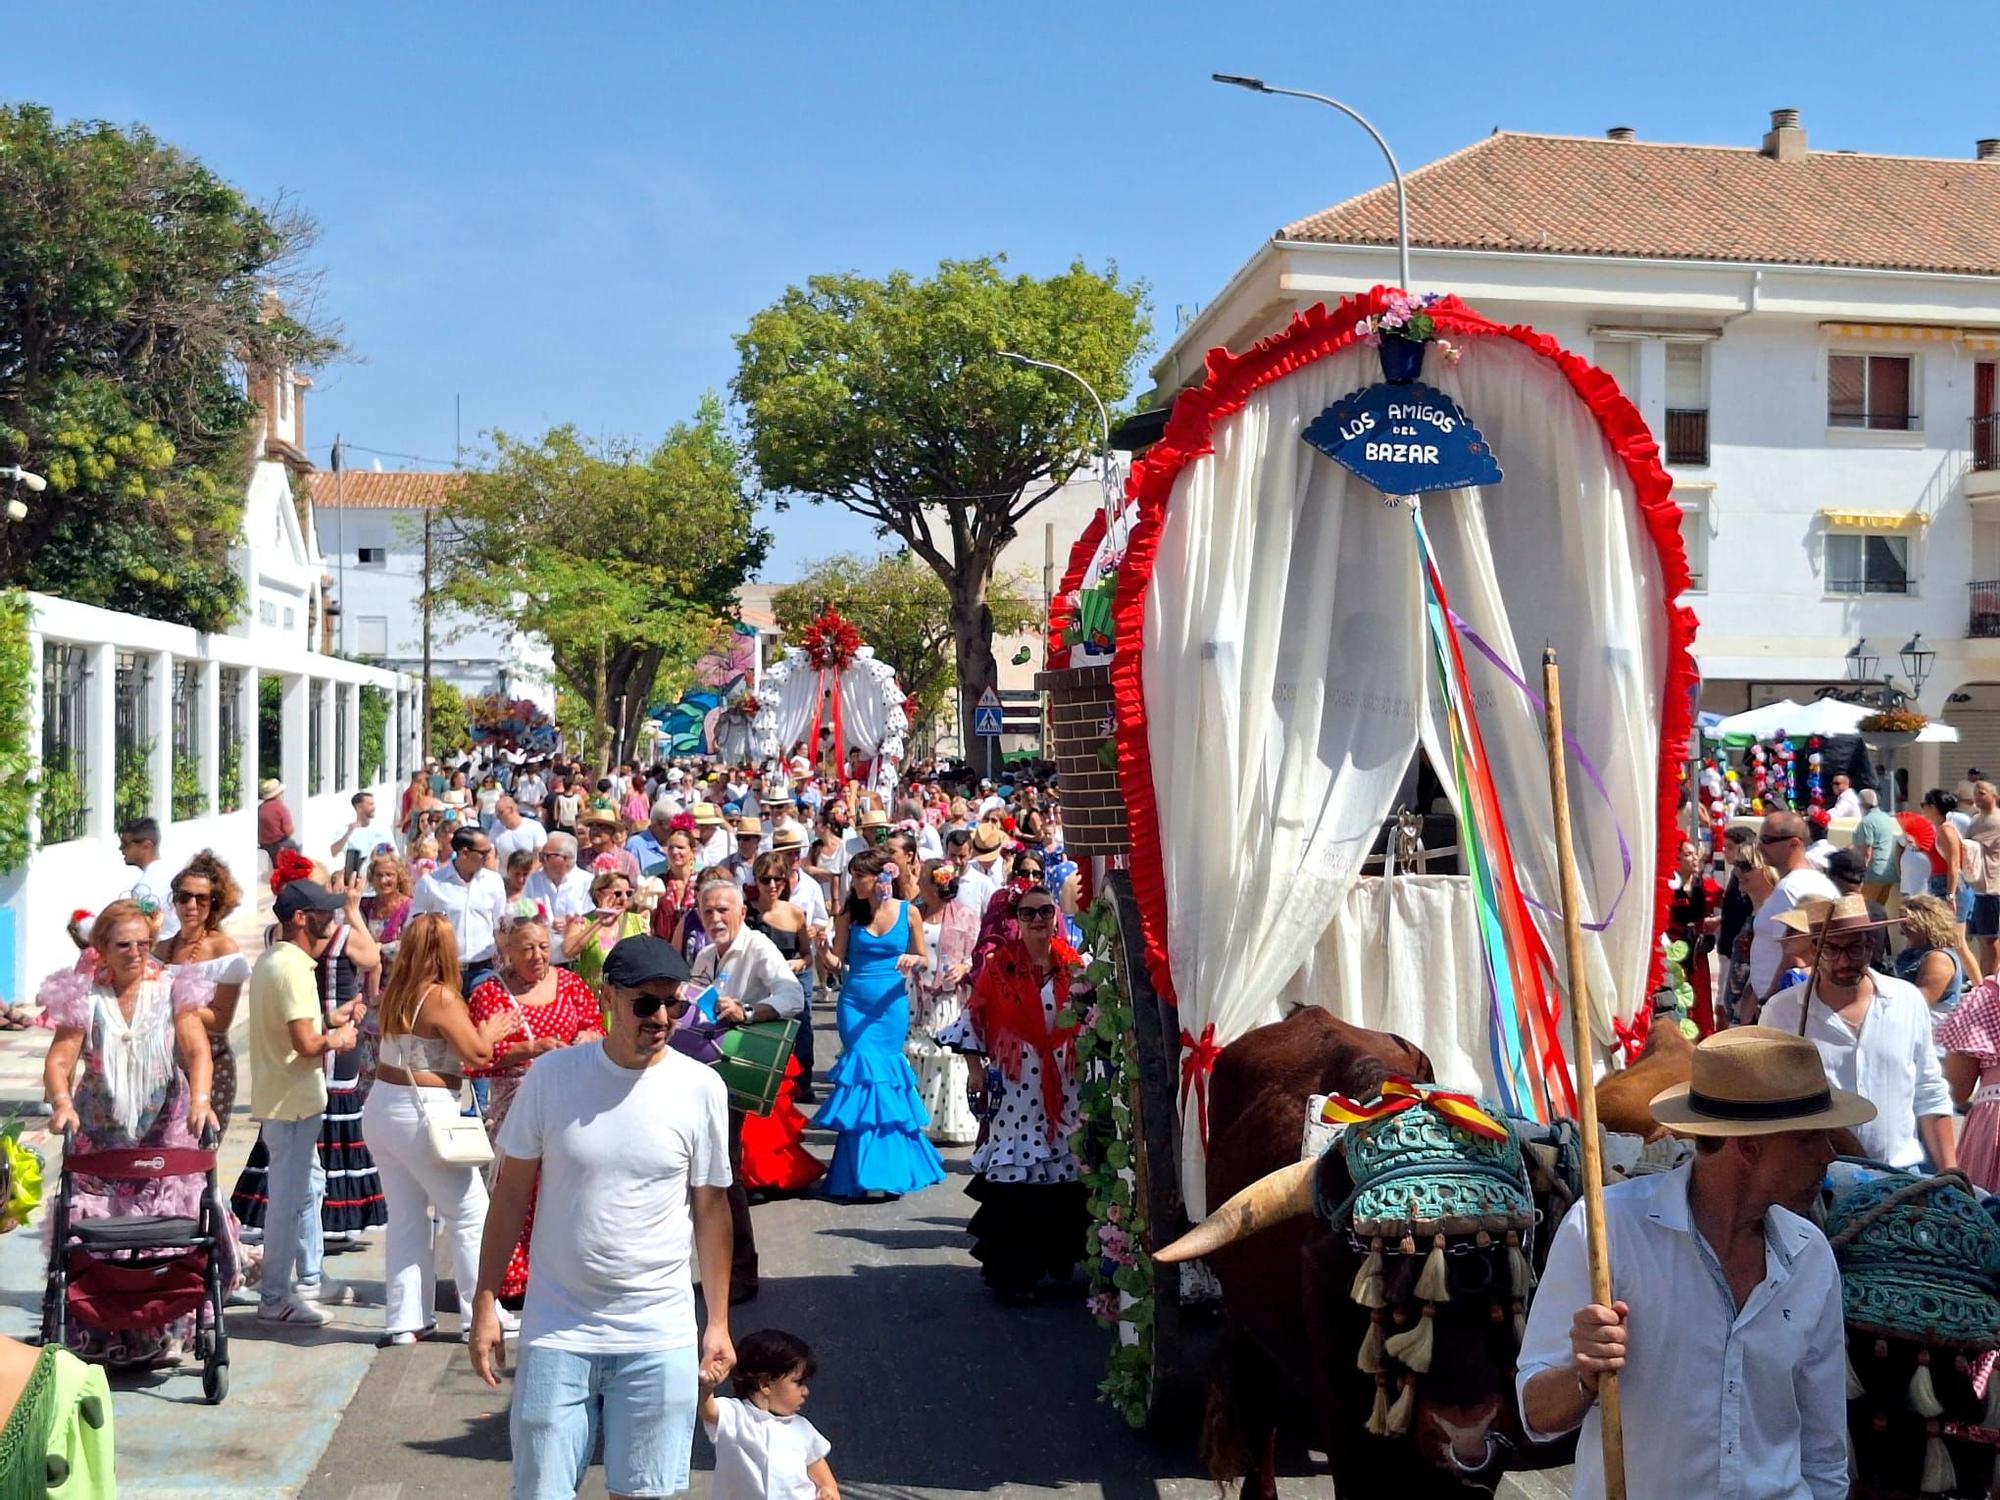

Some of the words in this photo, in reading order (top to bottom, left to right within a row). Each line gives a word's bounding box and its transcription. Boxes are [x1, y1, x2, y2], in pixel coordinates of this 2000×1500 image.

[1340, 412, 1376, 440] LOS
[1393, 426, 1418, 435] DEL
[1366, 442, 1439, 465] BAZAR
